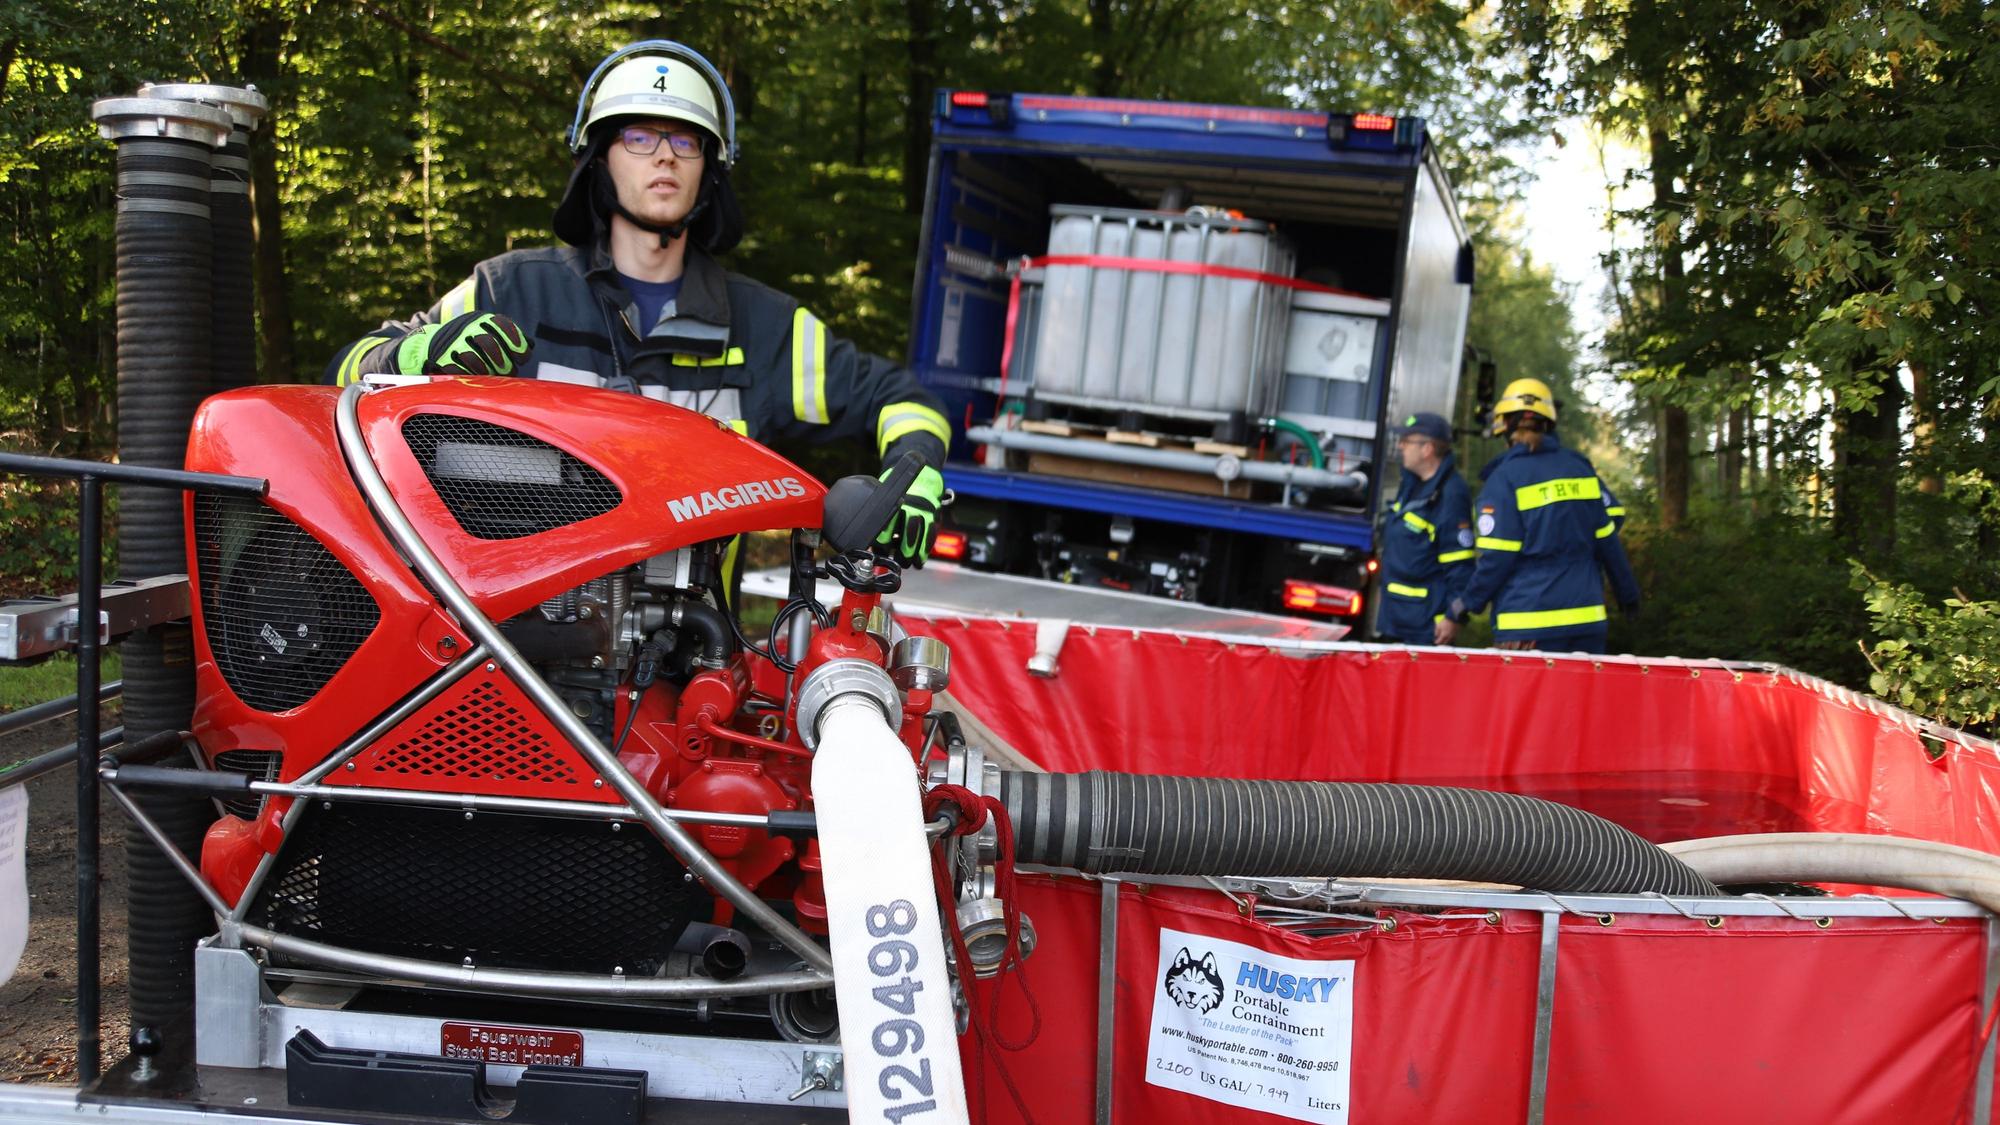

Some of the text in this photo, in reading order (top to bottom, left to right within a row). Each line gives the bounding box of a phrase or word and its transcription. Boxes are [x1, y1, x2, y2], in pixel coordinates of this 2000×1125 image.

[653, 76, 667, 93] 4
[666, 477, 806, 523] MAGIRUS
[1539, 483, 1580, 500] THW
[1236, 961, 1339, 1003] HUSKY
[865, 899, 937, 1125] 129498
[1234, 990, 1289, 1016] Portable
[1219, 1021, 1250, 1036] Leader
[1250, 1028, 1261, 1037] of
[1260, 1030, 1274, 1041] the
[1232, 1005, 1325, 1037] Containment
[469, 1028, 554, 1048] Feuerwehr
[1161, 1026, 1339, 1073] www.huskyportable.com 800-260-9950
[445, 1043, 577, 1067] Stadt Bad Honnef
[1187, 1046, 1197, 1054] US
[1197, 1049, 1217, 1060] Patent
[1263, 1063, 1276, 1073] and
[1156, 1057, 1194, 1077] 2100
[1200, 1071, 1216, 1085] US
[1307, 1096, 1342, 1111] Liters
